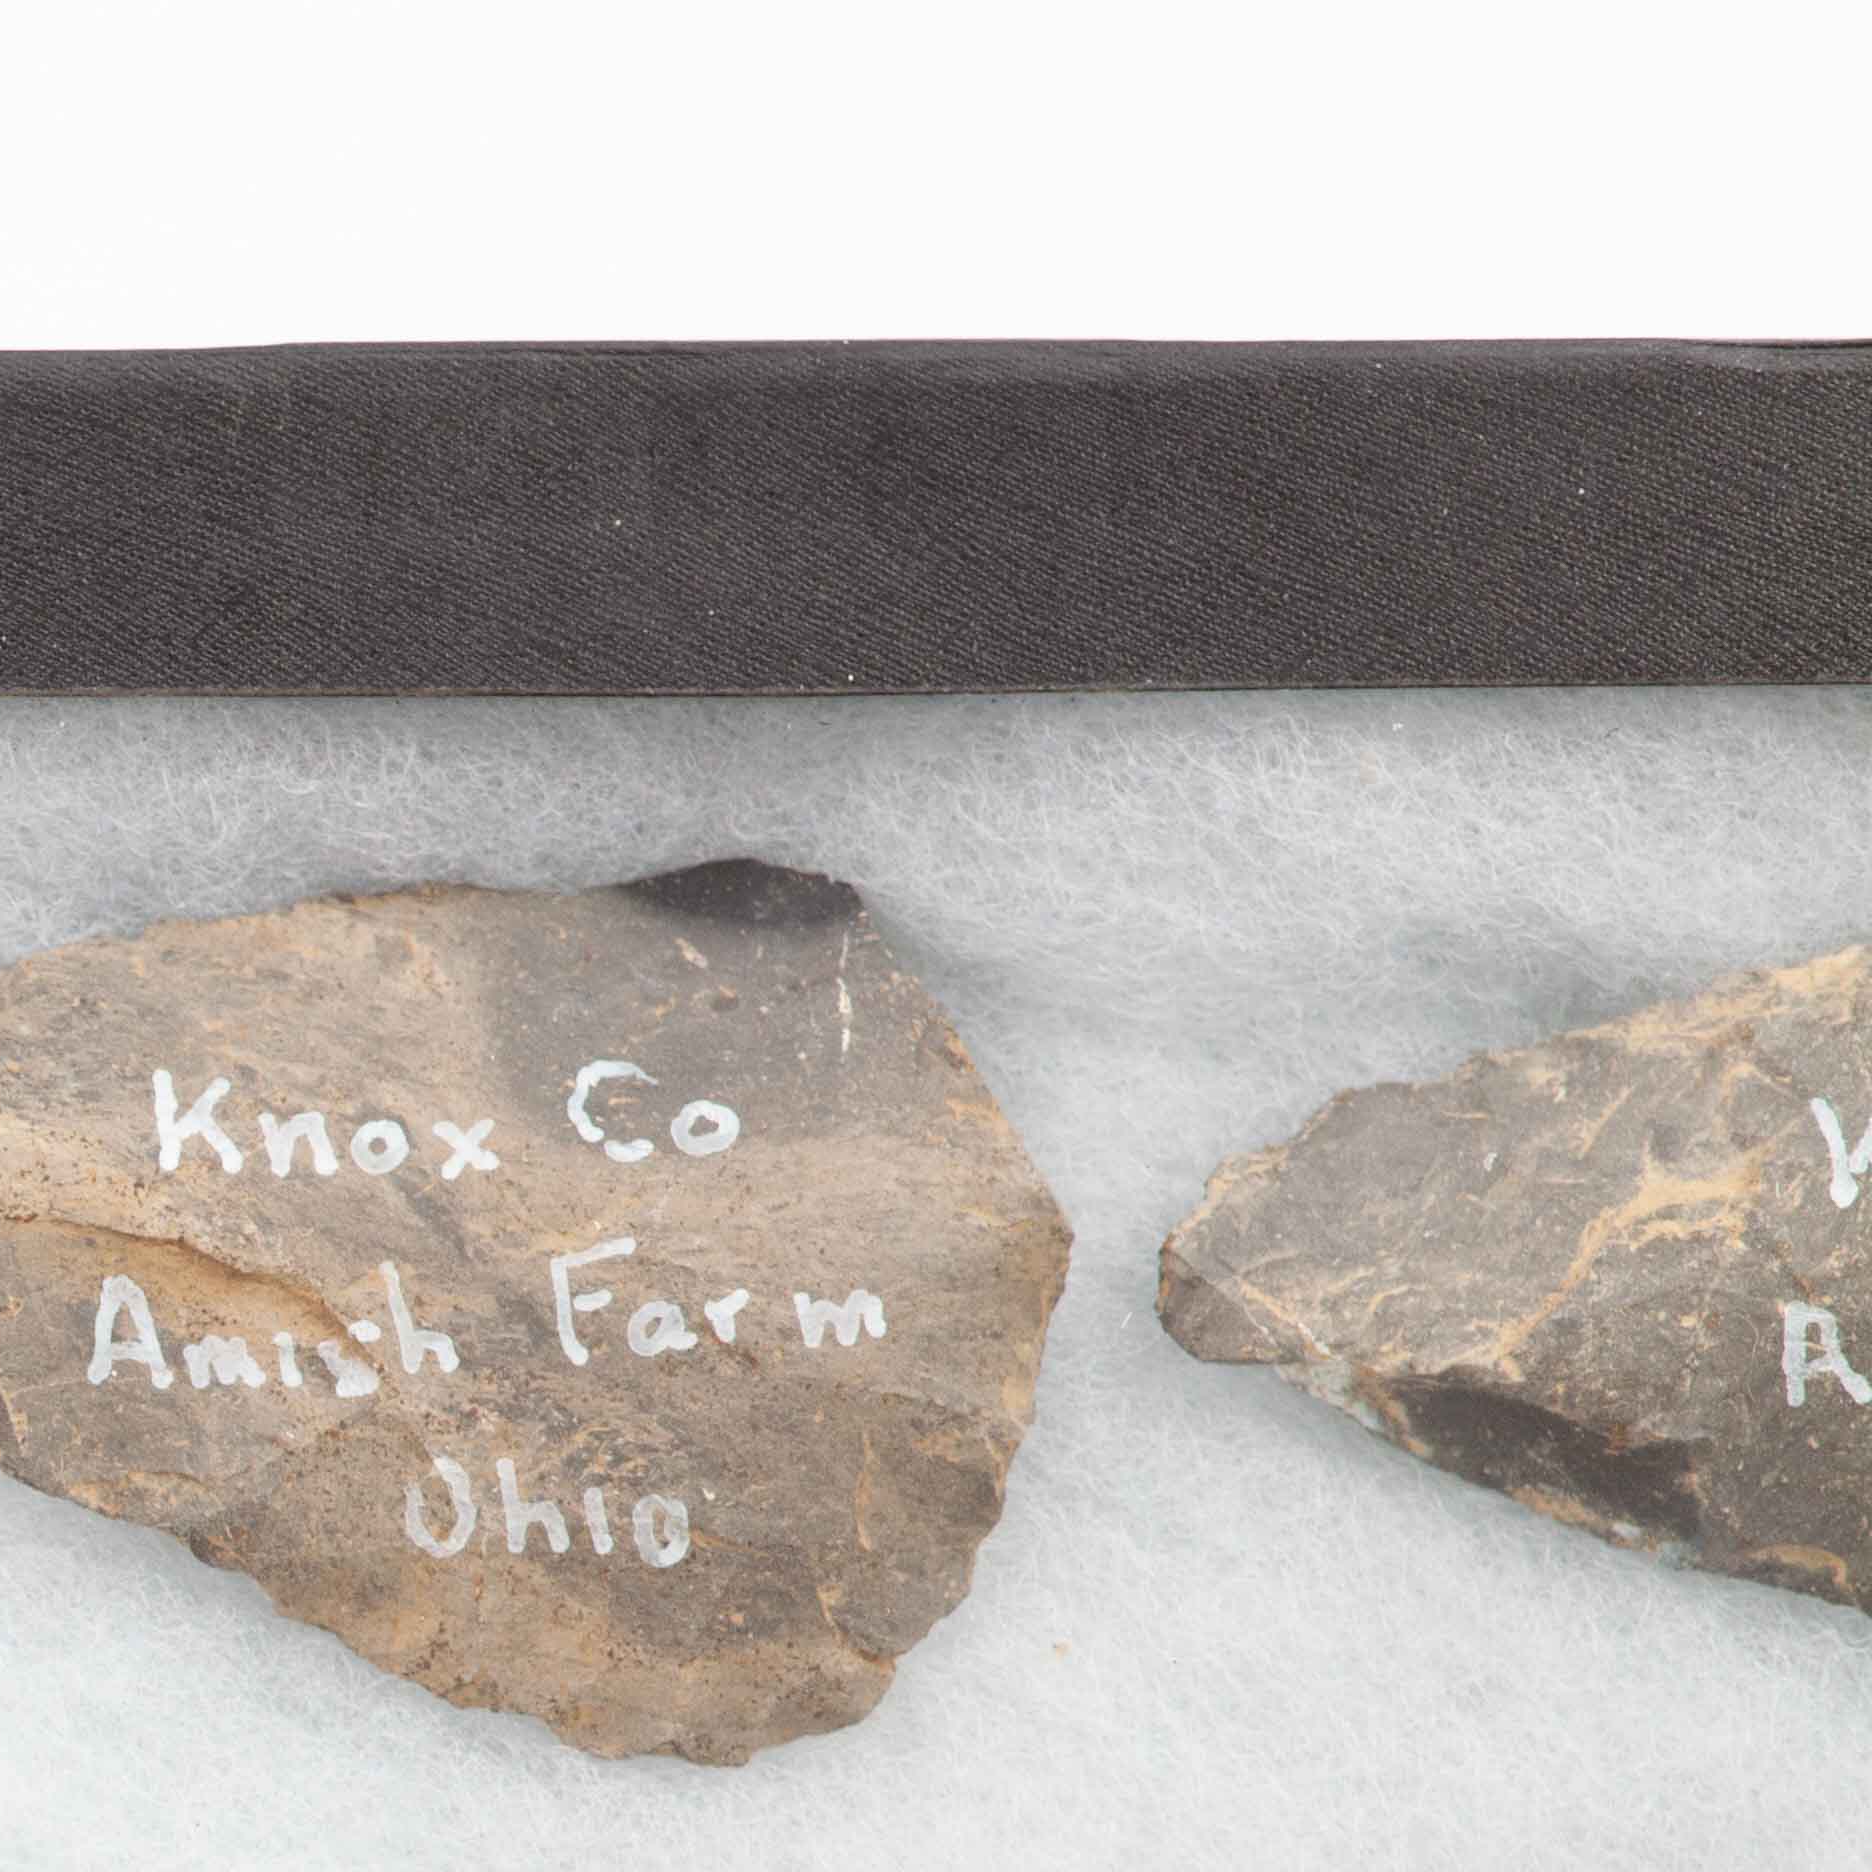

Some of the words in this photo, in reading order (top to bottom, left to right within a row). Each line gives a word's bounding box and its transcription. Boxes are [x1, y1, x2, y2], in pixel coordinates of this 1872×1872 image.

[153, 1069, 500, 1180] Knox
[566, 1059, 742, 1164] Co
[87, 1262, 459, 1398] Amish
[550, 1237, 888, 1367] Farm
[404, 1456, 691, 1567] Ohio
